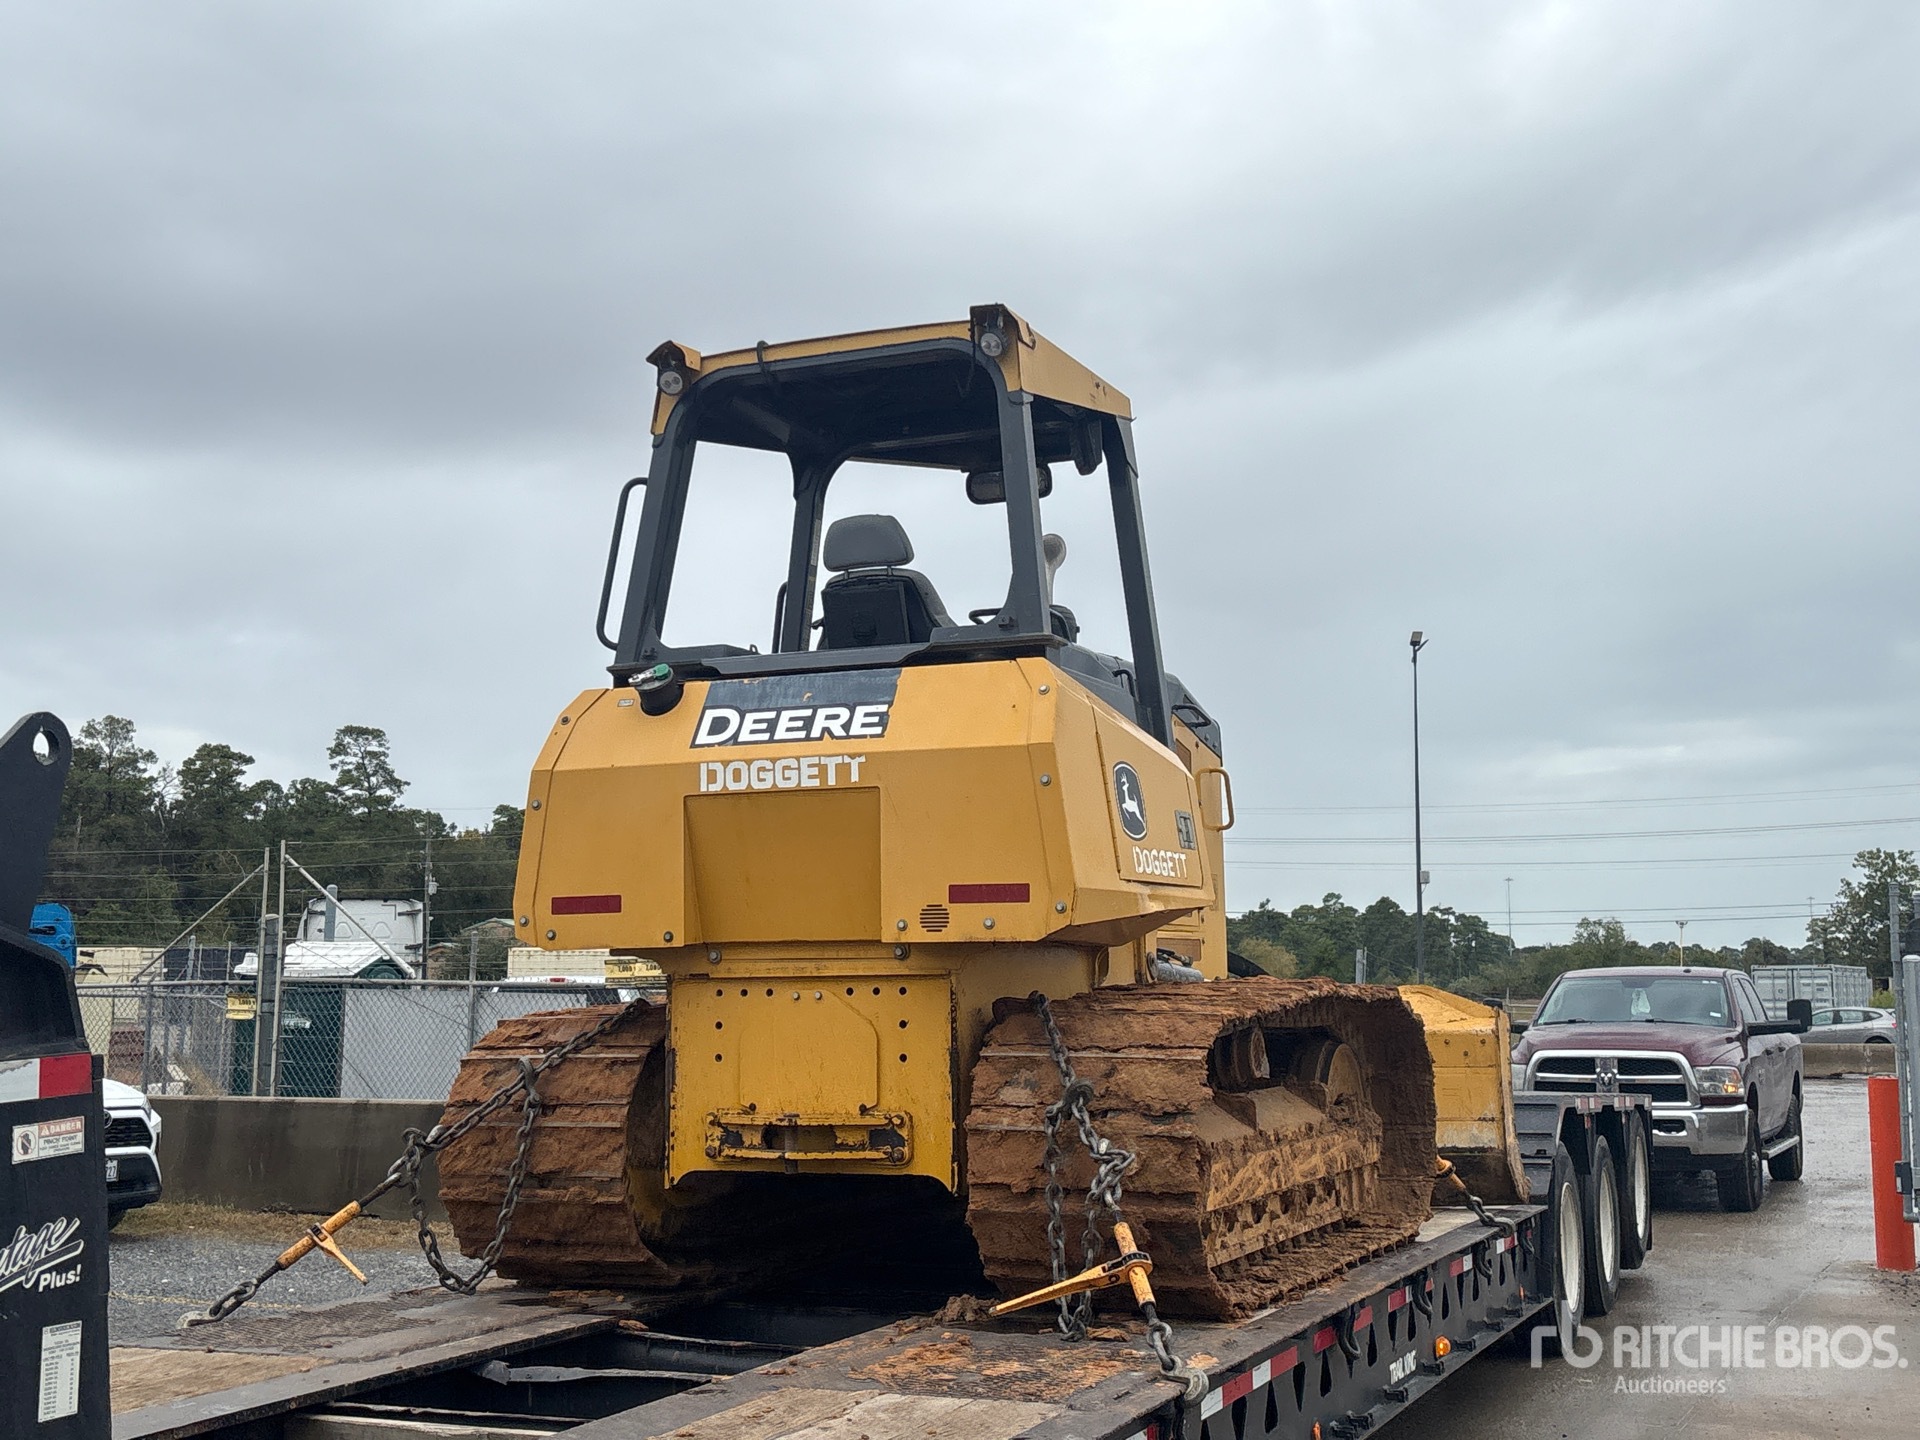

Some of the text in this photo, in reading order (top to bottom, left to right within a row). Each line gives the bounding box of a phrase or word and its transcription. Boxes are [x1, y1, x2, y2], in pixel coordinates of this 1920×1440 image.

[695, 704, 888, 745] DEERE
[700, 755, 866, 792] DOGGETT
[1133, 846, 1187, 878] DOGGETT
[50, 1121, 81, 1134] DANGER
[38, 1264, 82, 1292] Plus!
